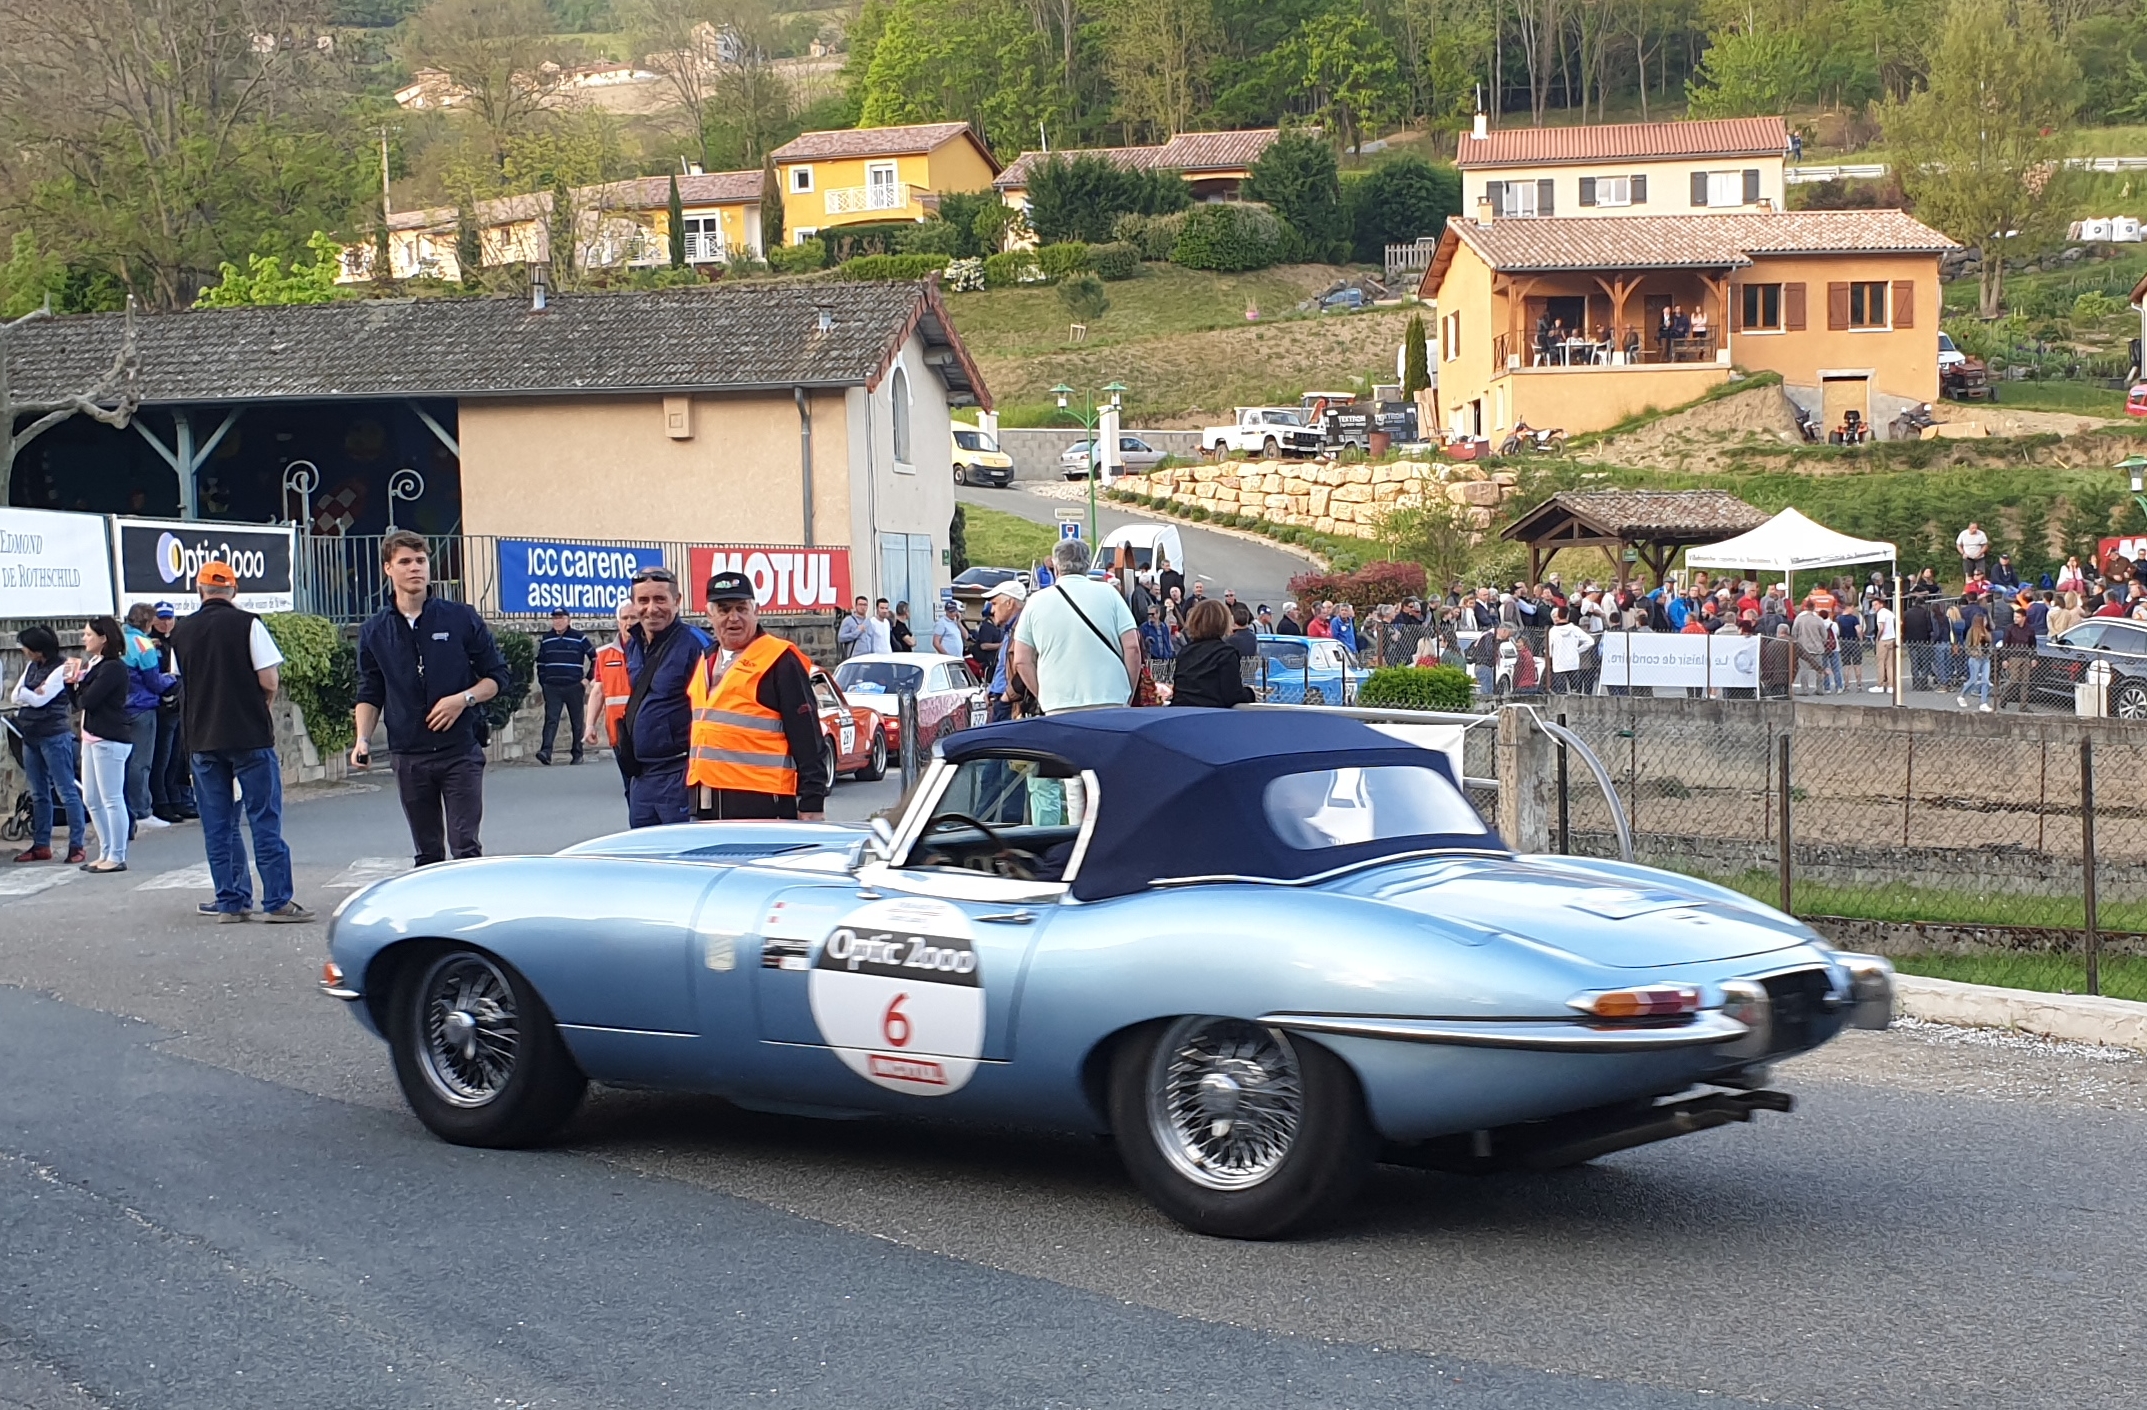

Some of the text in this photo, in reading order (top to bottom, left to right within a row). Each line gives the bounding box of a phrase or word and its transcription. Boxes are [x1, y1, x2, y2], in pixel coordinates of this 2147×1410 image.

[0, 529, 43, 554] EDMOND
[2, 563, 81, 588] DE ROTHSCHILD
[527, 547, 638, 580] ICC carene
[827, 929, 904, 971] Optic
[903, 936, 976, 974] 2000
[880, 991, 911, 1048] 6
